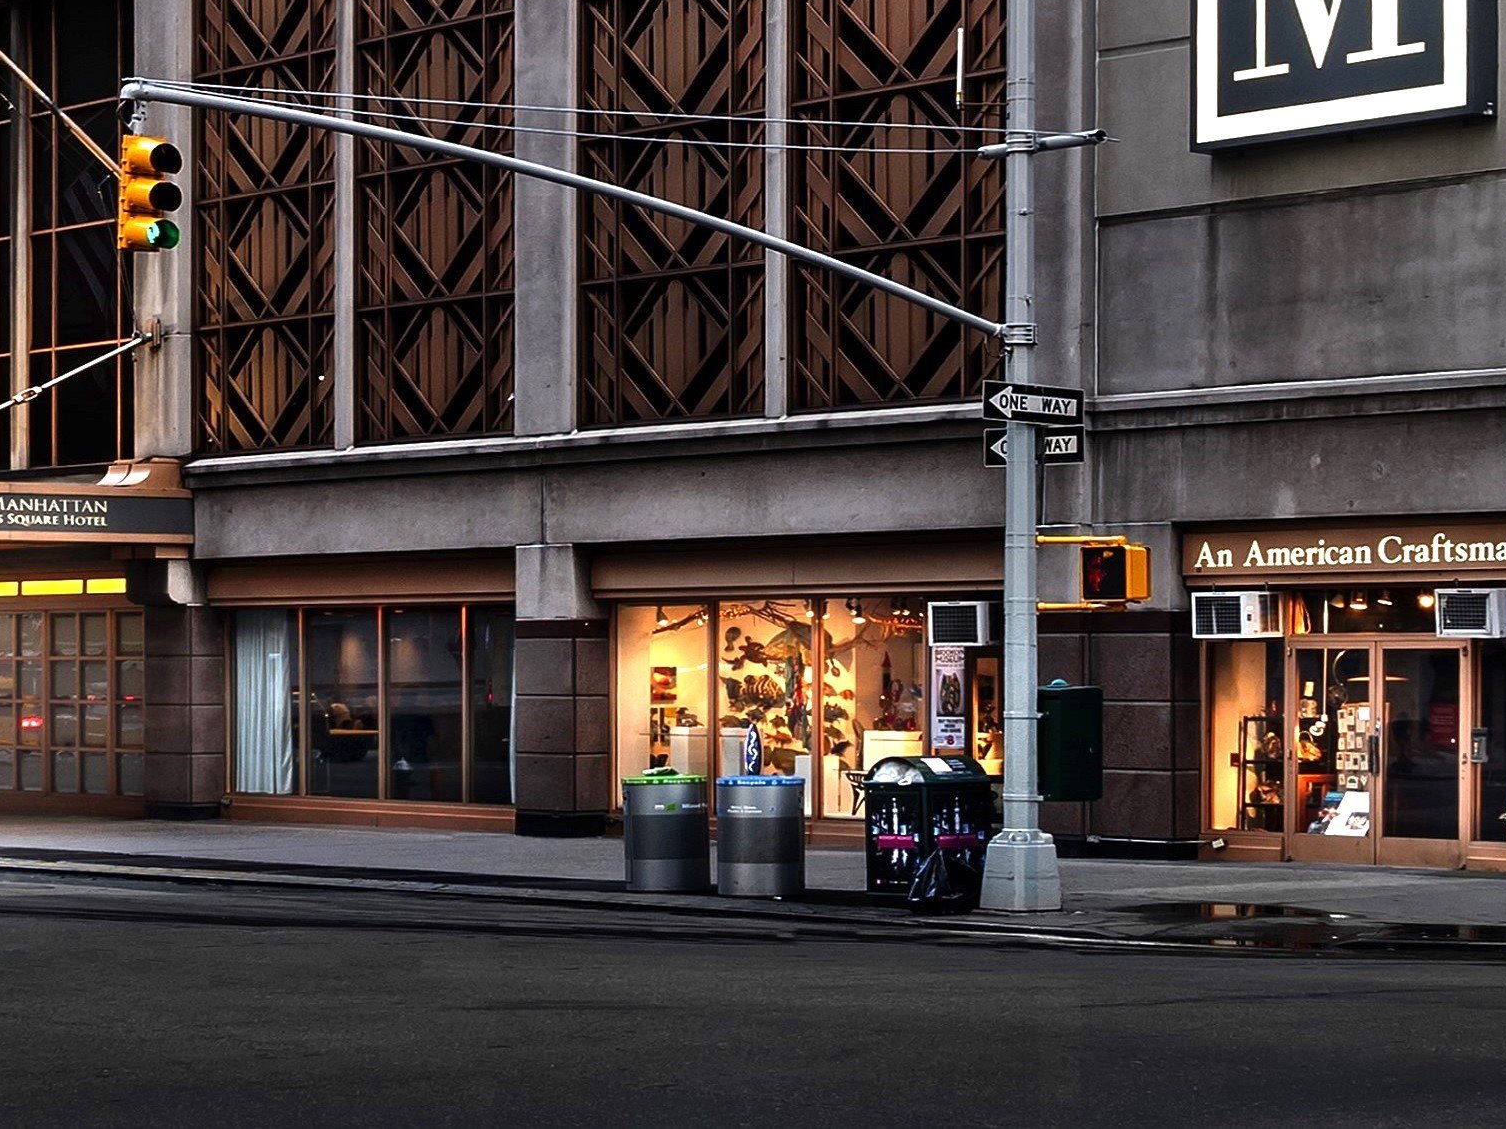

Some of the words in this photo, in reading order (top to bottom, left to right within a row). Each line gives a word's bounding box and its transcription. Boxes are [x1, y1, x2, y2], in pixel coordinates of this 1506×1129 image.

[999, 394, 1028, 411] ONE
[1042, 397, 1072, 414] WAY
[6, 513, 60, 527] SQUARE
[63, 514, 108, 527] HOTEL
[1194, 541, 1233, 568] An
[1243, 539, 1372, 567] American
